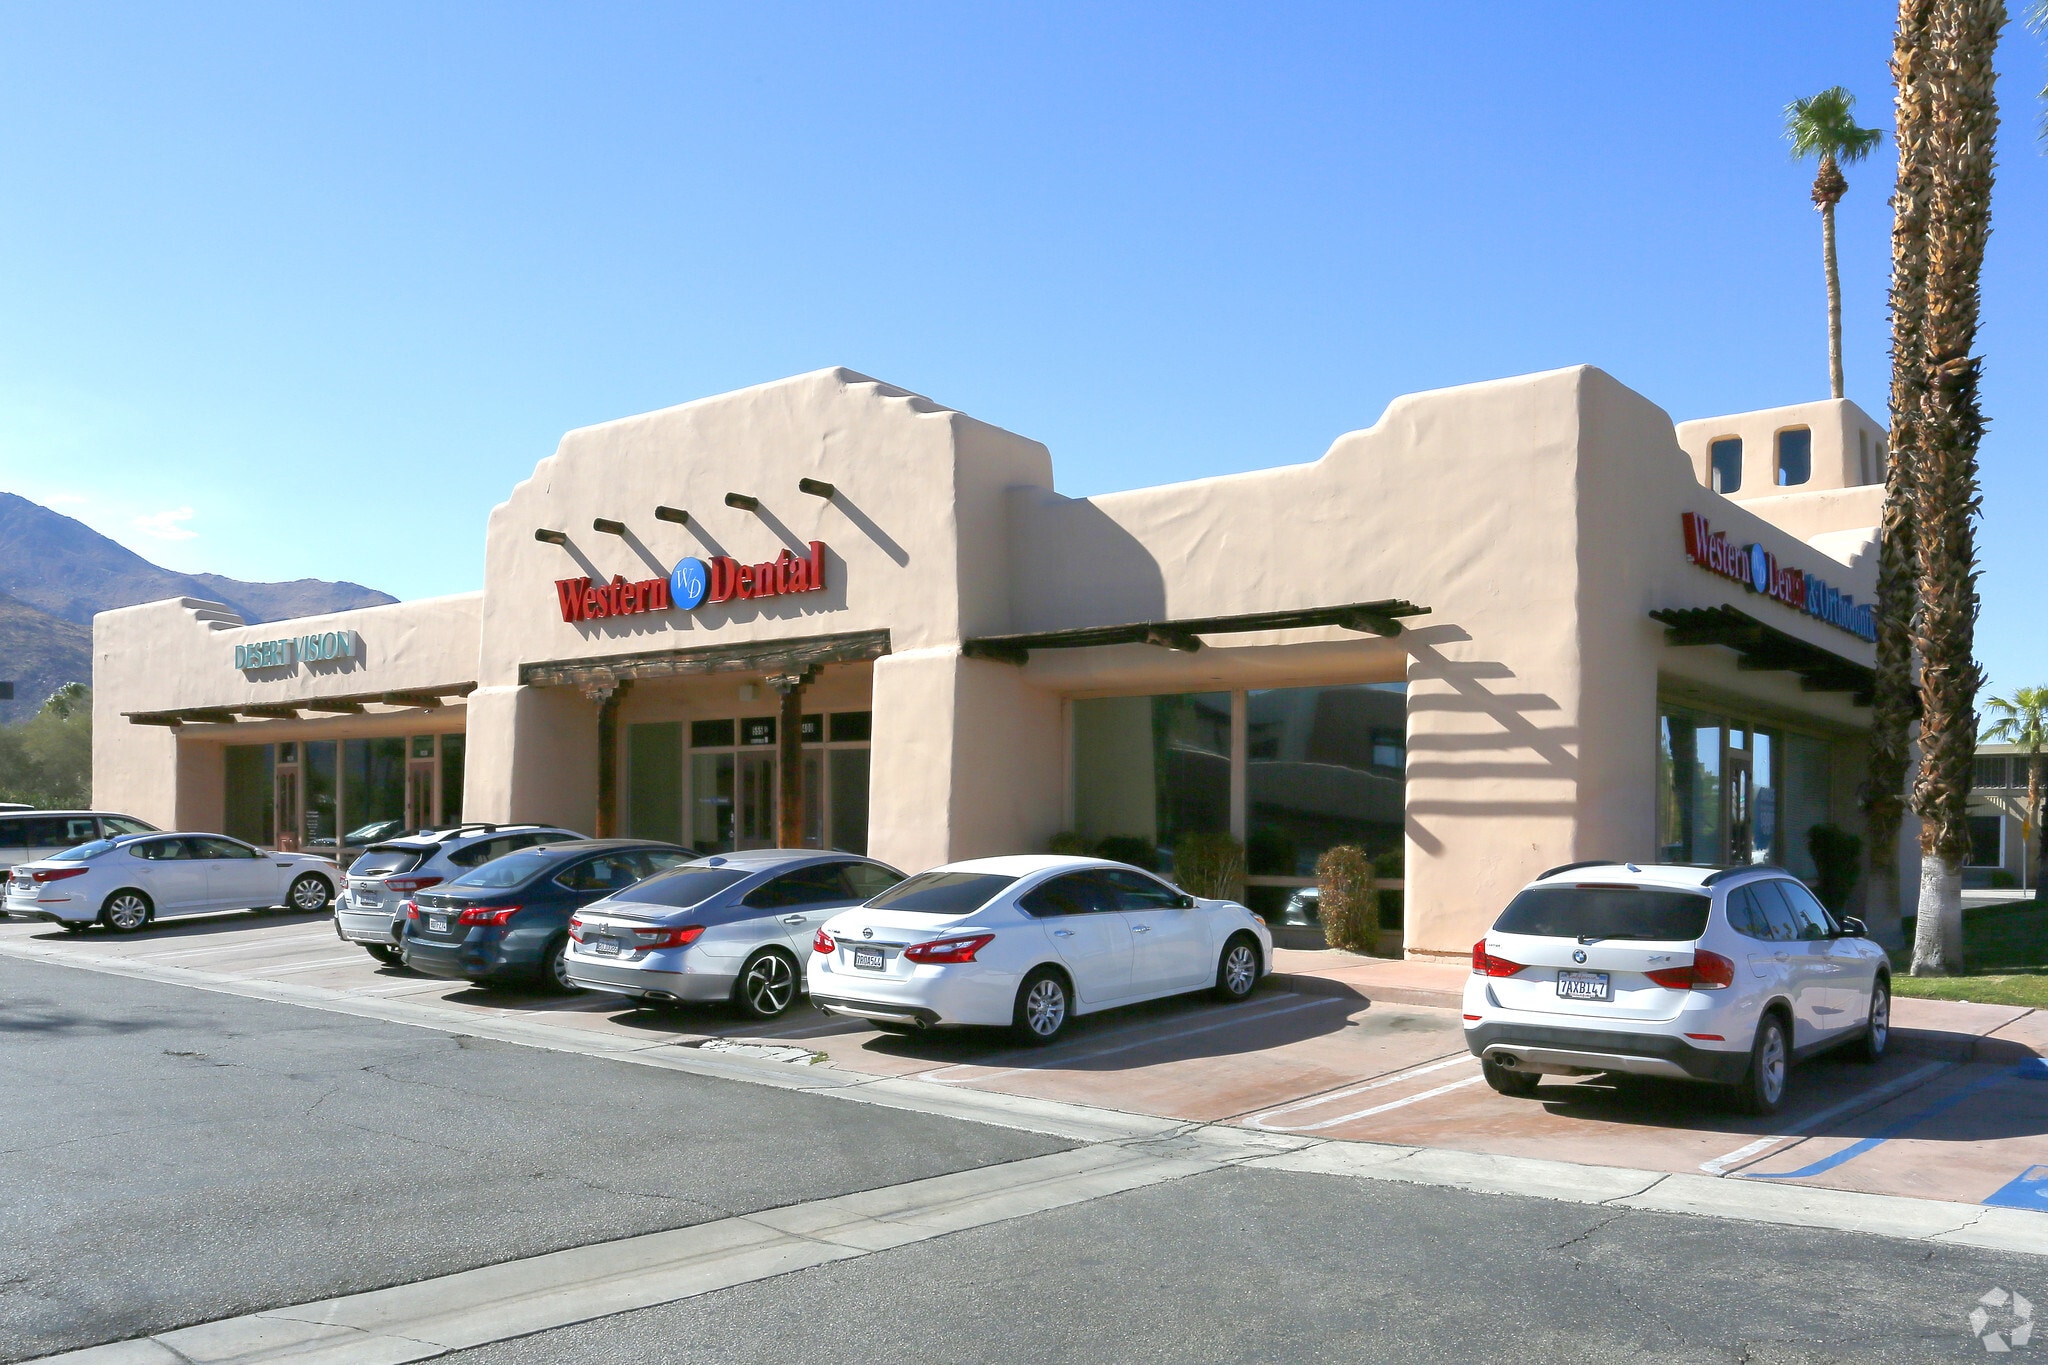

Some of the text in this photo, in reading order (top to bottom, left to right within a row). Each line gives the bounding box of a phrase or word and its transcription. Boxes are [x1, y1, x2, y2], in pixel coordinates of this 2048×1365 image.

[1684, 511, 1750, 584] Western
[555, 540, 827, 623] Western WD Dental
[234, 629, 357, 670] DESERT VISION
[1560, 980, 1605, 996] 7AXB147
